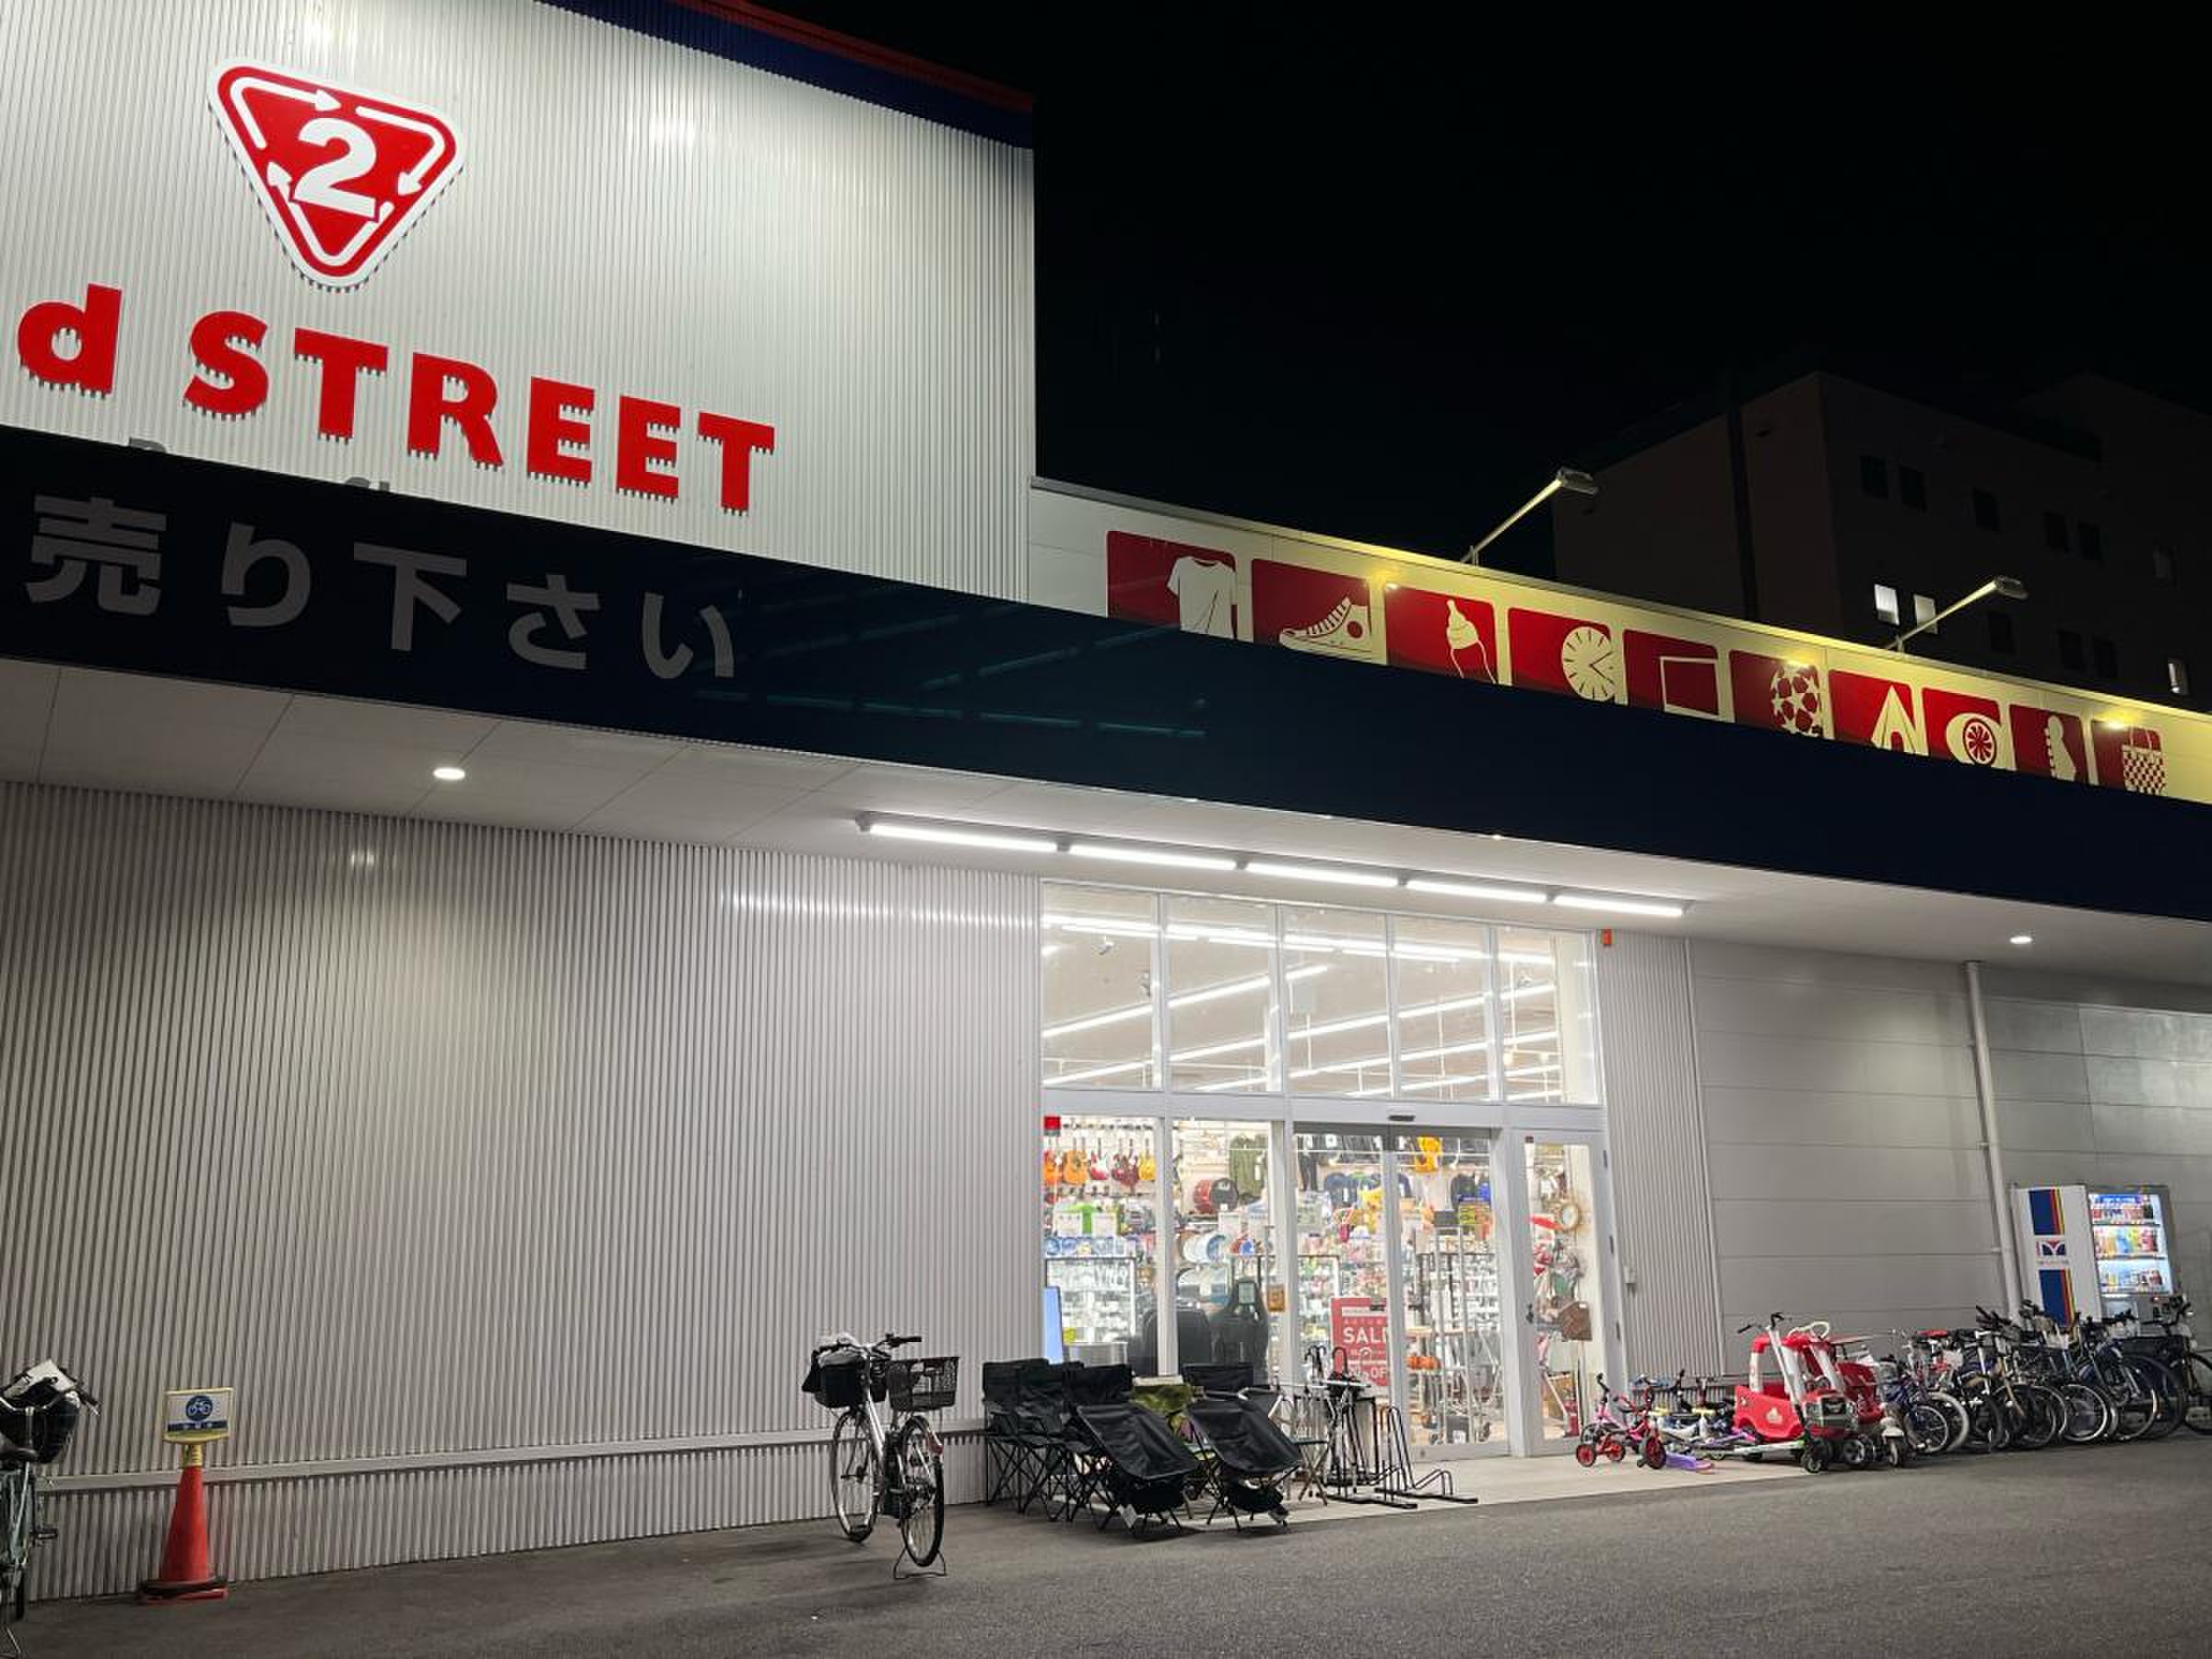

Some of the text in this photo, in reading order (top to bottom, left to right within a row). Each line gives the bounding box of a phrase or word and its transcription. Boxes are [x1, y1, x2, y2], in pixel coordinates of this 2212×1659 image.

[294, 118, 377, 218] 2
[18, 284, 775, 514] d STREET
[26, 493, 736, 679] 売り下さい
